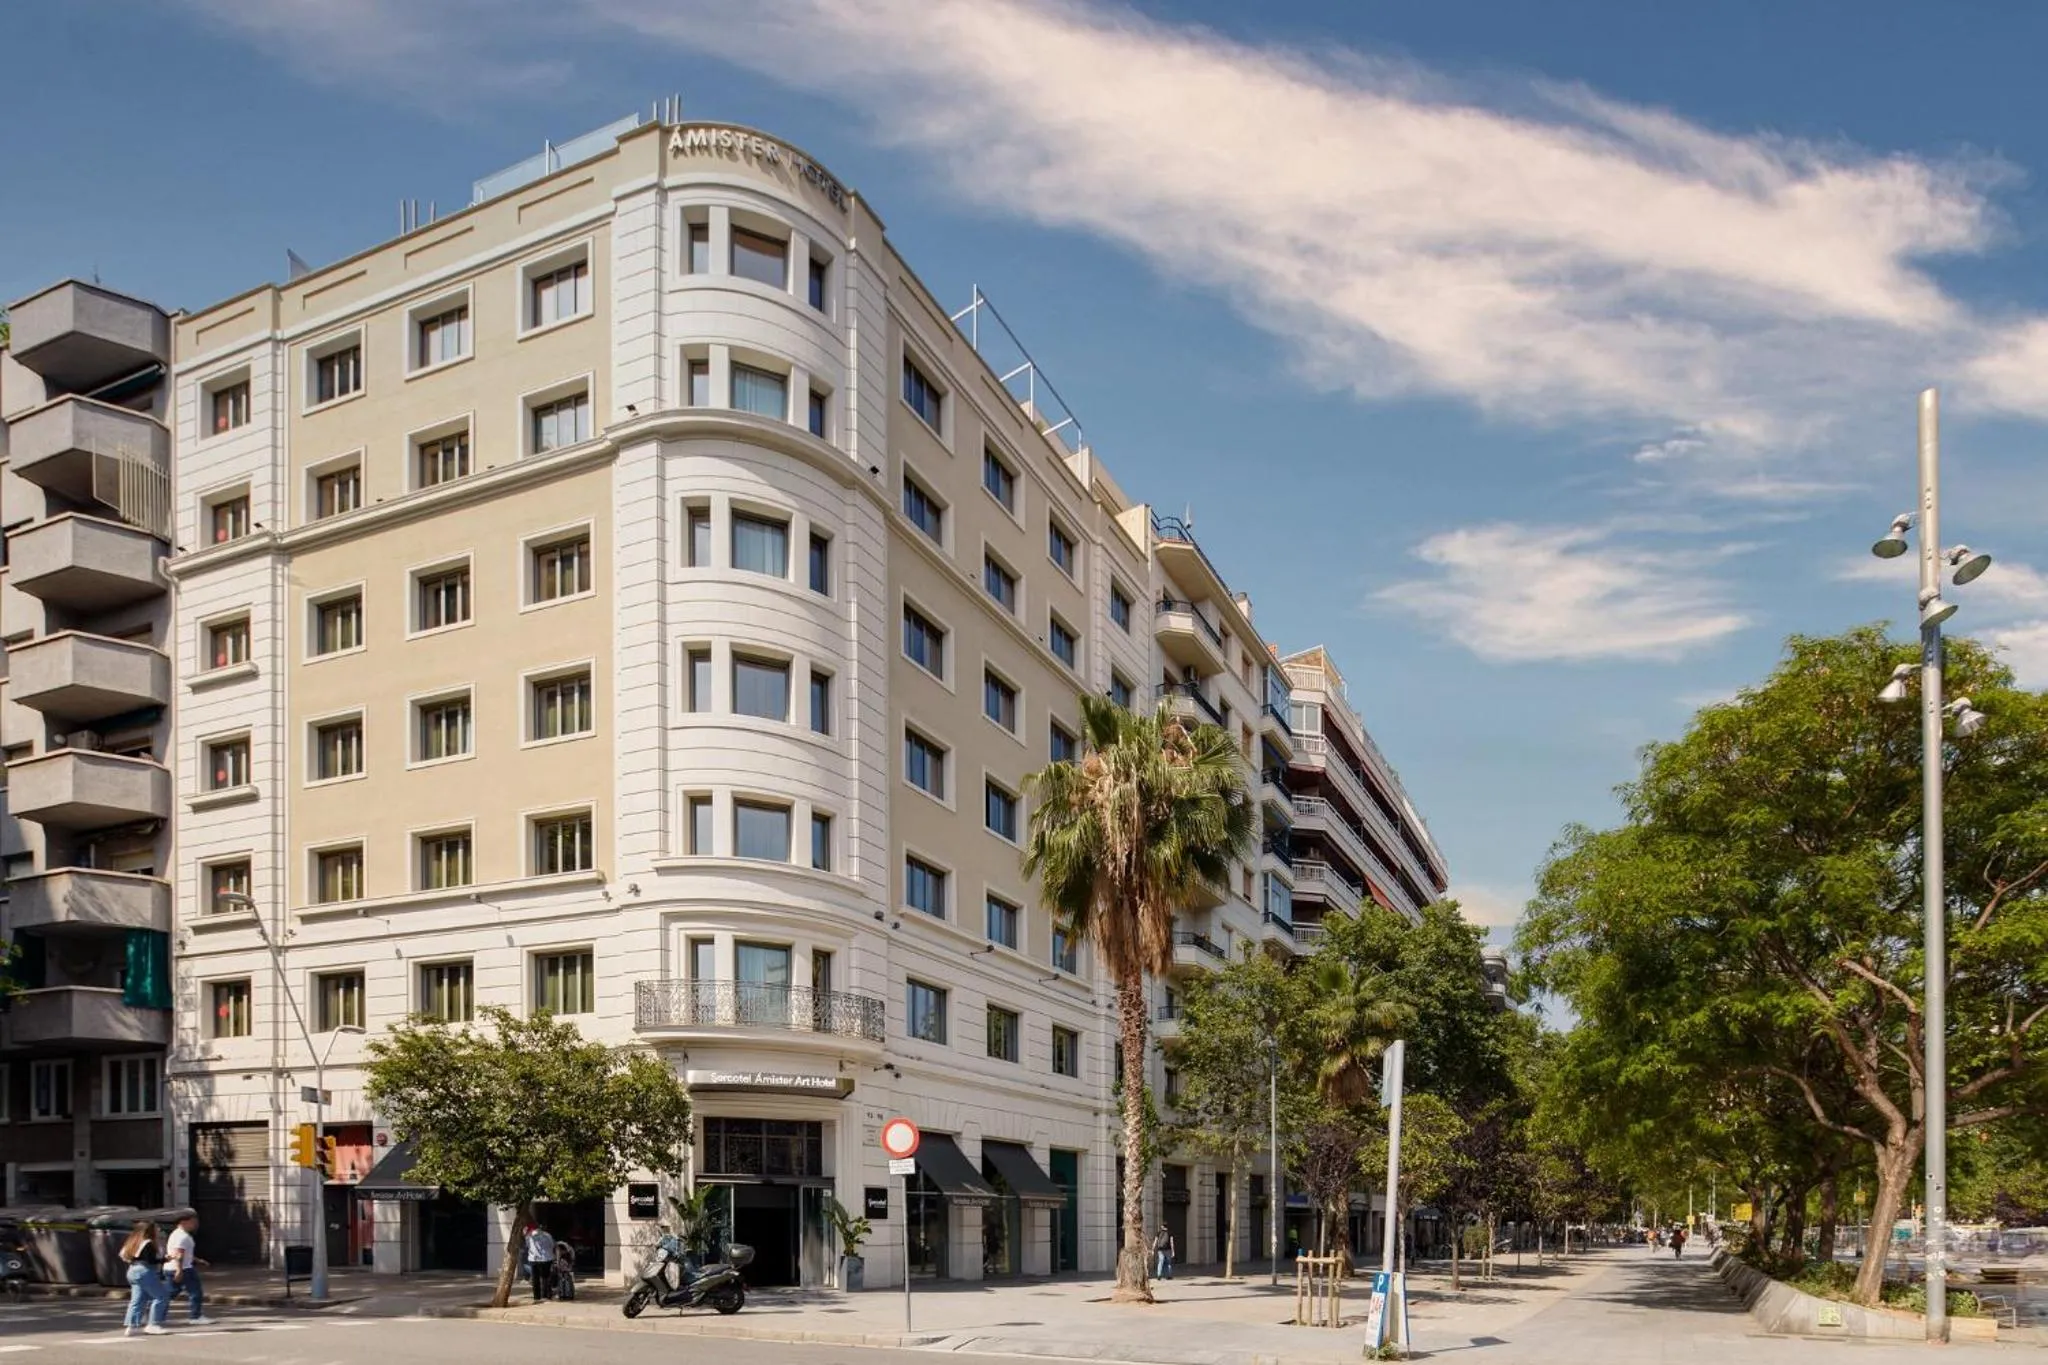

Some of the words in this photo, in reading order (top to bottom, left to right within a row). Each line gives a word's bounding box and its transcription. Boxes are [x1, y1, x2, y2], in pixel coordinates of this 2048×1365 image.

[668, 125, 780, 164] ÁMISTER
[796, 1076, 811, 1087] Art
[811, 1077, 837, 1088] Hotel
[1377, 1274, 1384, 1292] P
